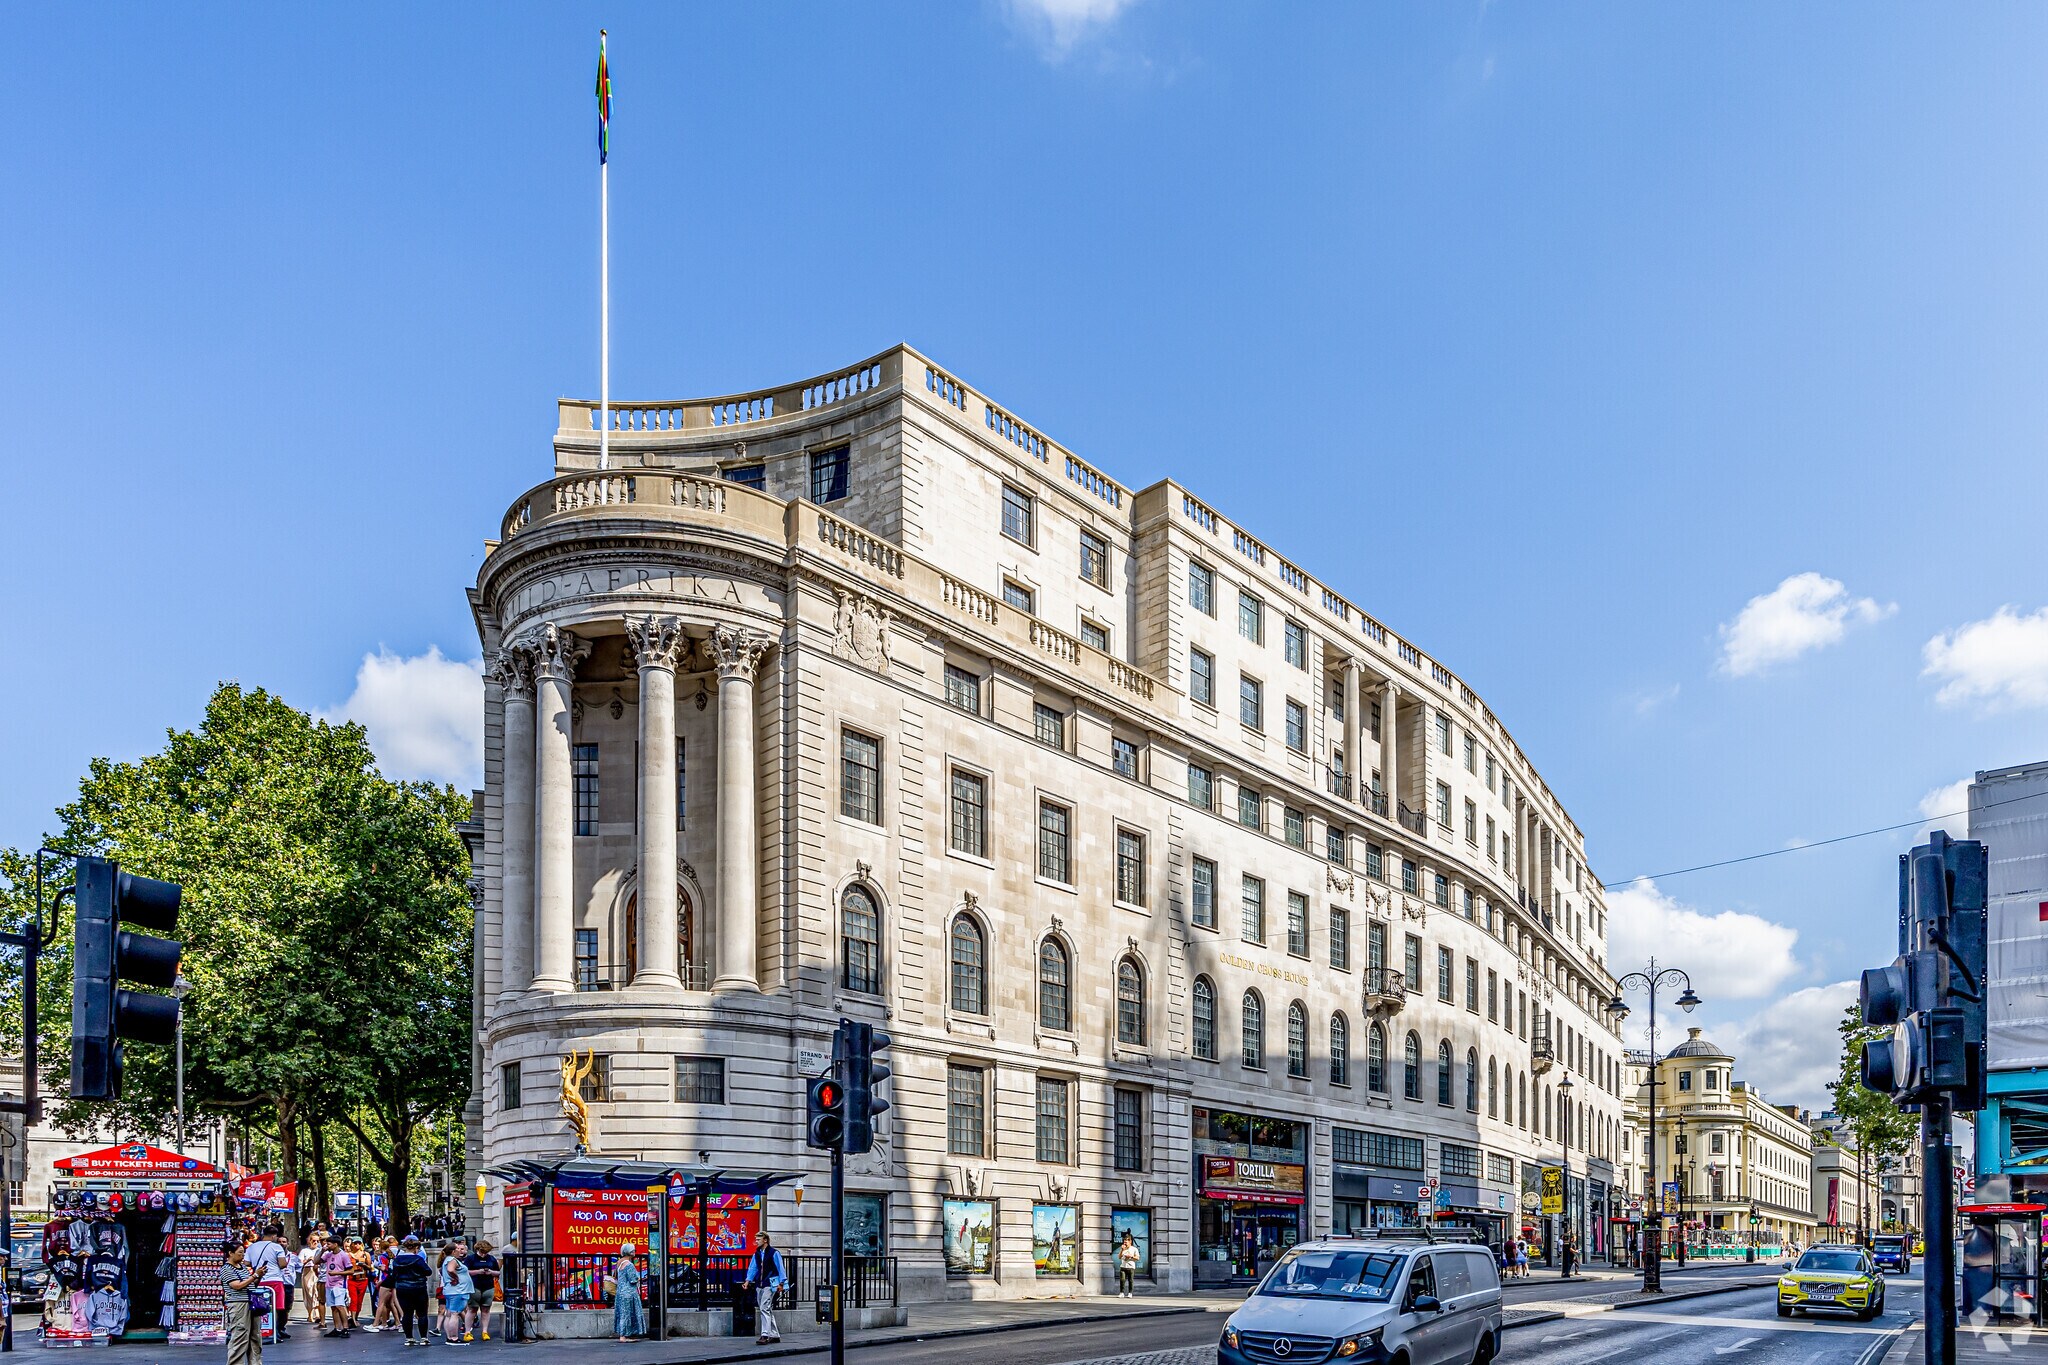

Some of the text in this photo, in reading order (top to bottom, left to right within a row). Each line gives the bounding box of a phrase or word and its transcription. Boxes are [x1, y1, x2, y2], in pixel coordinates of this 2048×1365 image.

[1220, 953, 1309, 987] GOLDEN CROSS HOUSE
[800, 1051, 822, 1059] STRAND
[113, 1160, 153, 1168] TICKETS
[155, 1161, 180, 1169] HERE
[1238, 1163, 1275, 1179] TORTILLA
[113, 1181, 124, 1189] £1
[191, 1182, 202, 1190] £1
[602, 1193, 622, 1201] BUY
[625, 1193, 649, 1202] YOU
[573, 1210, 649, 1222] Hop On Hop Off
[567, 1225, 604, 1235] AUDIO
[606, 1226, 640, 1235] GUIDE
[571, 1236, 649, 1246] 11 LANGUAGES
[92, 1263, 121, 1276] LONDON
